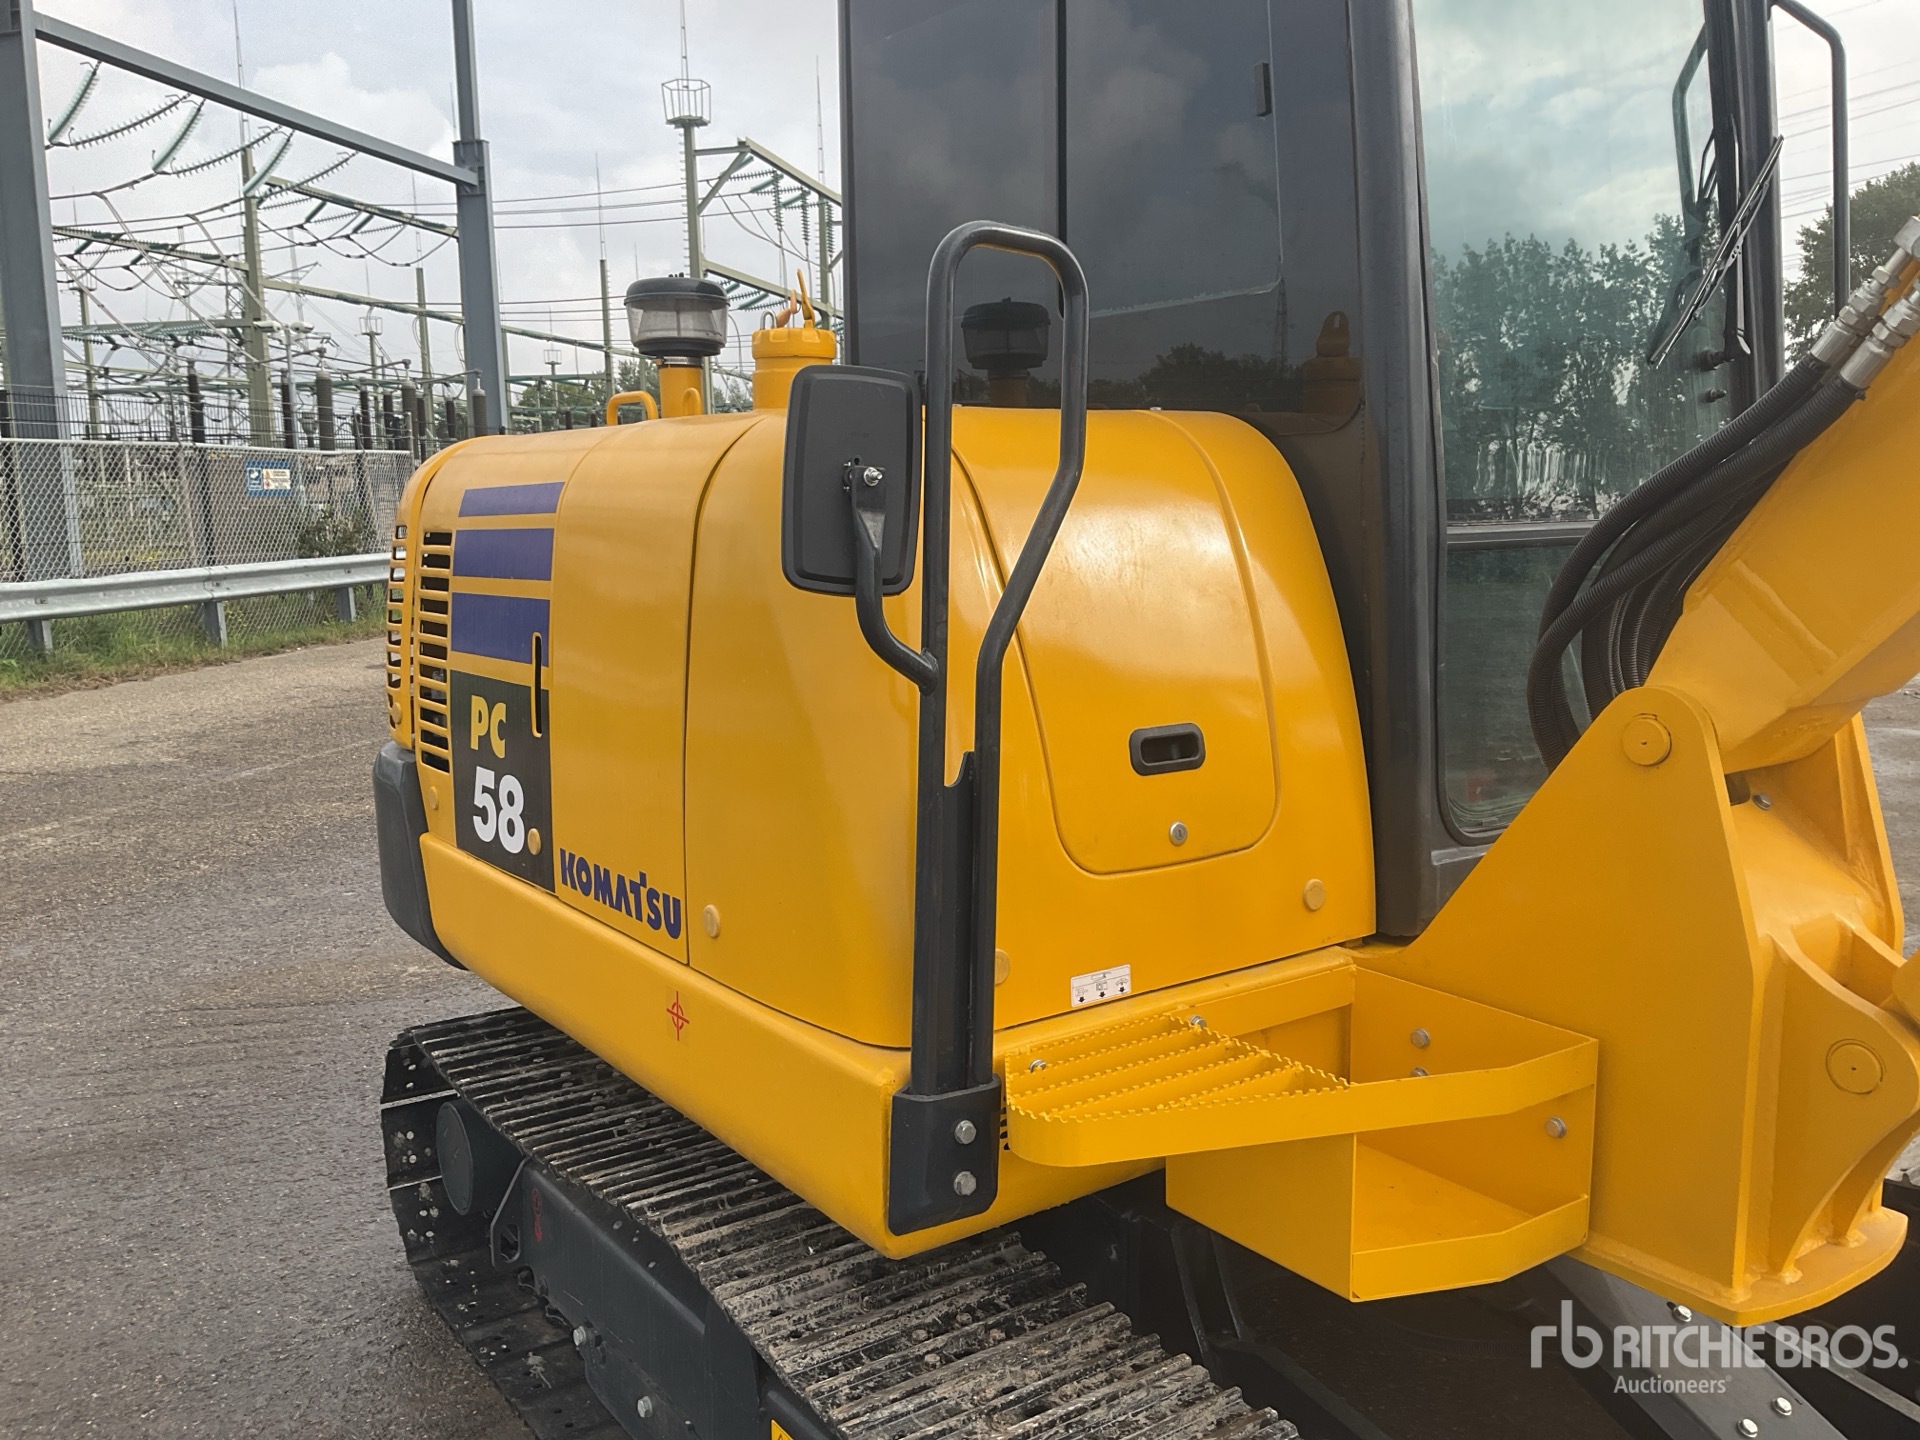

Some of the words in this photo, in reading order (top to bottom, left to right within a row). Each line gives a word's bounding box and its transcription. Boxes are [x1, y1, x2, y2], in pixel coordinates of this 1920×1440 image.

[470, 695, 507, 758] PC
[472, 765, 525, 854] 58
[559, 847, 682, 940] KOMATSU
